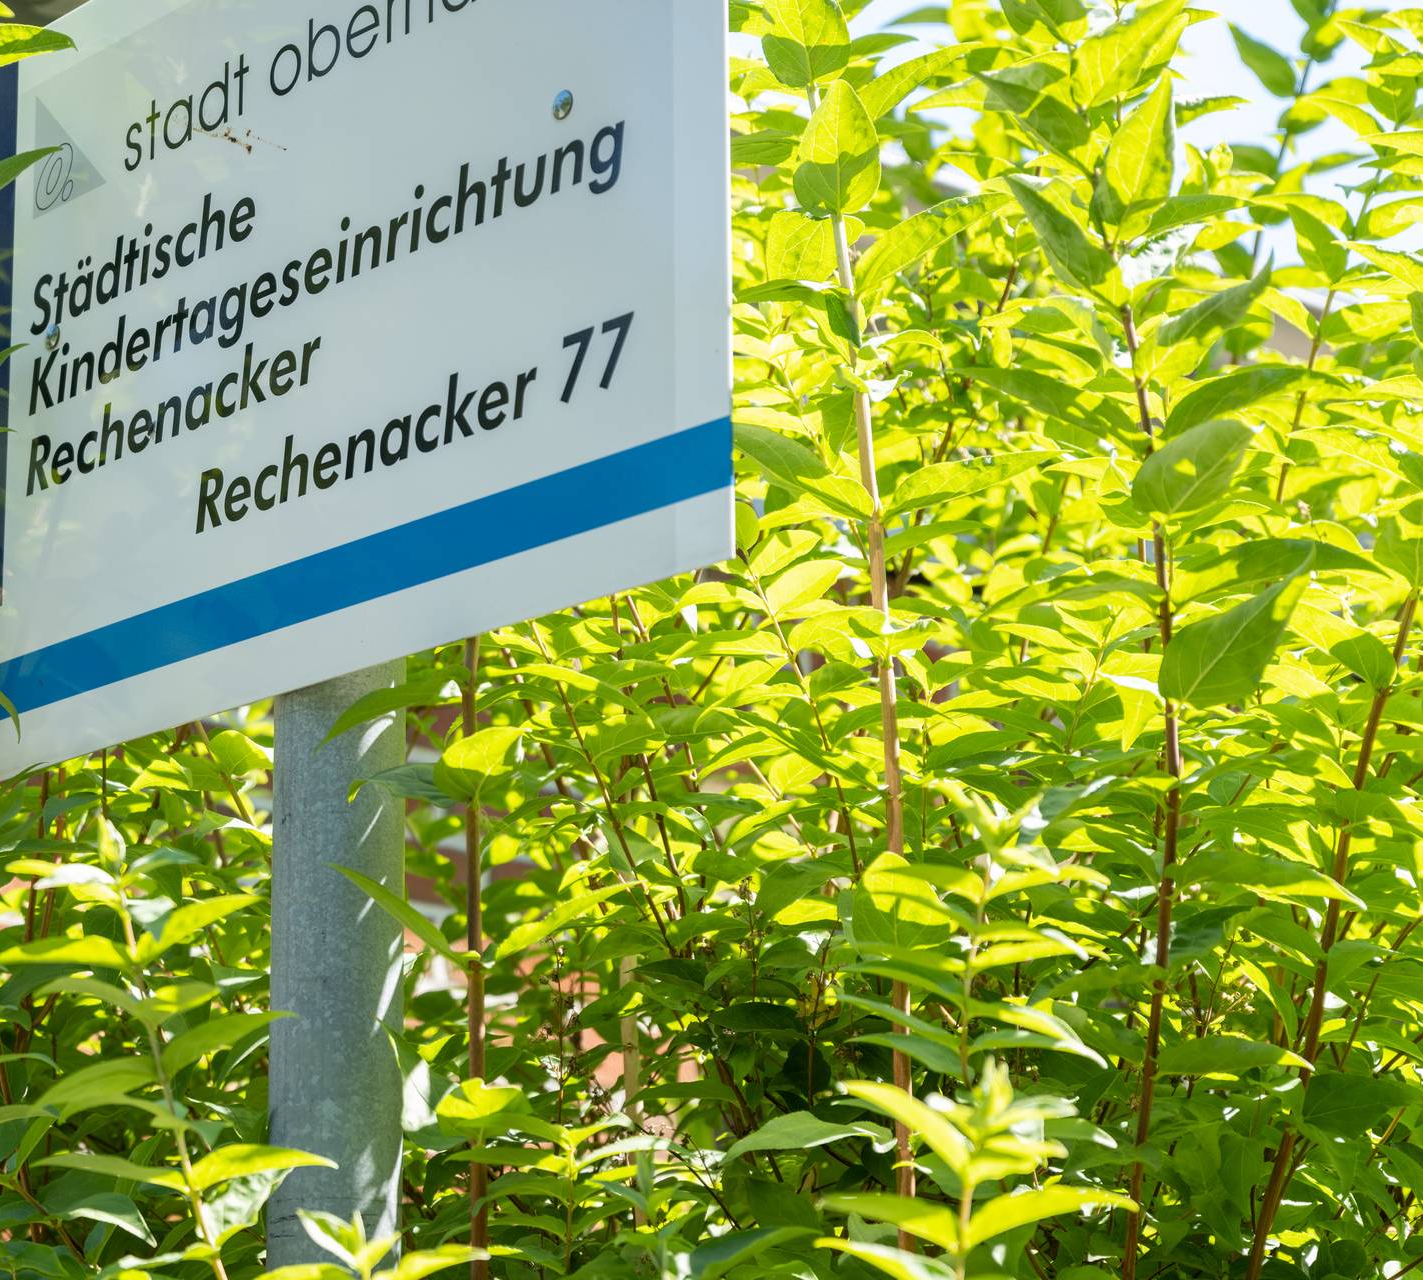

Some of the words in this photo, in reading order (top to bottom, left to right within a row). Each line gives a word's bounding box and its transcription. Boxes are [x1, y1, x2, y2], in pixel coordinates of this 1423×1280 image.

[124, 54, 250, 172] stadt
[269, 0, 475, 97] ober
[28, 120, 626, 417] Kindertageseinrichtung
[30, 191, 256, 336] Städtische
[25, 336, 322, 497] Rechenacker
[195, 366, 538, 535] Rechenacker
[559, 311, 635, 404] 77
